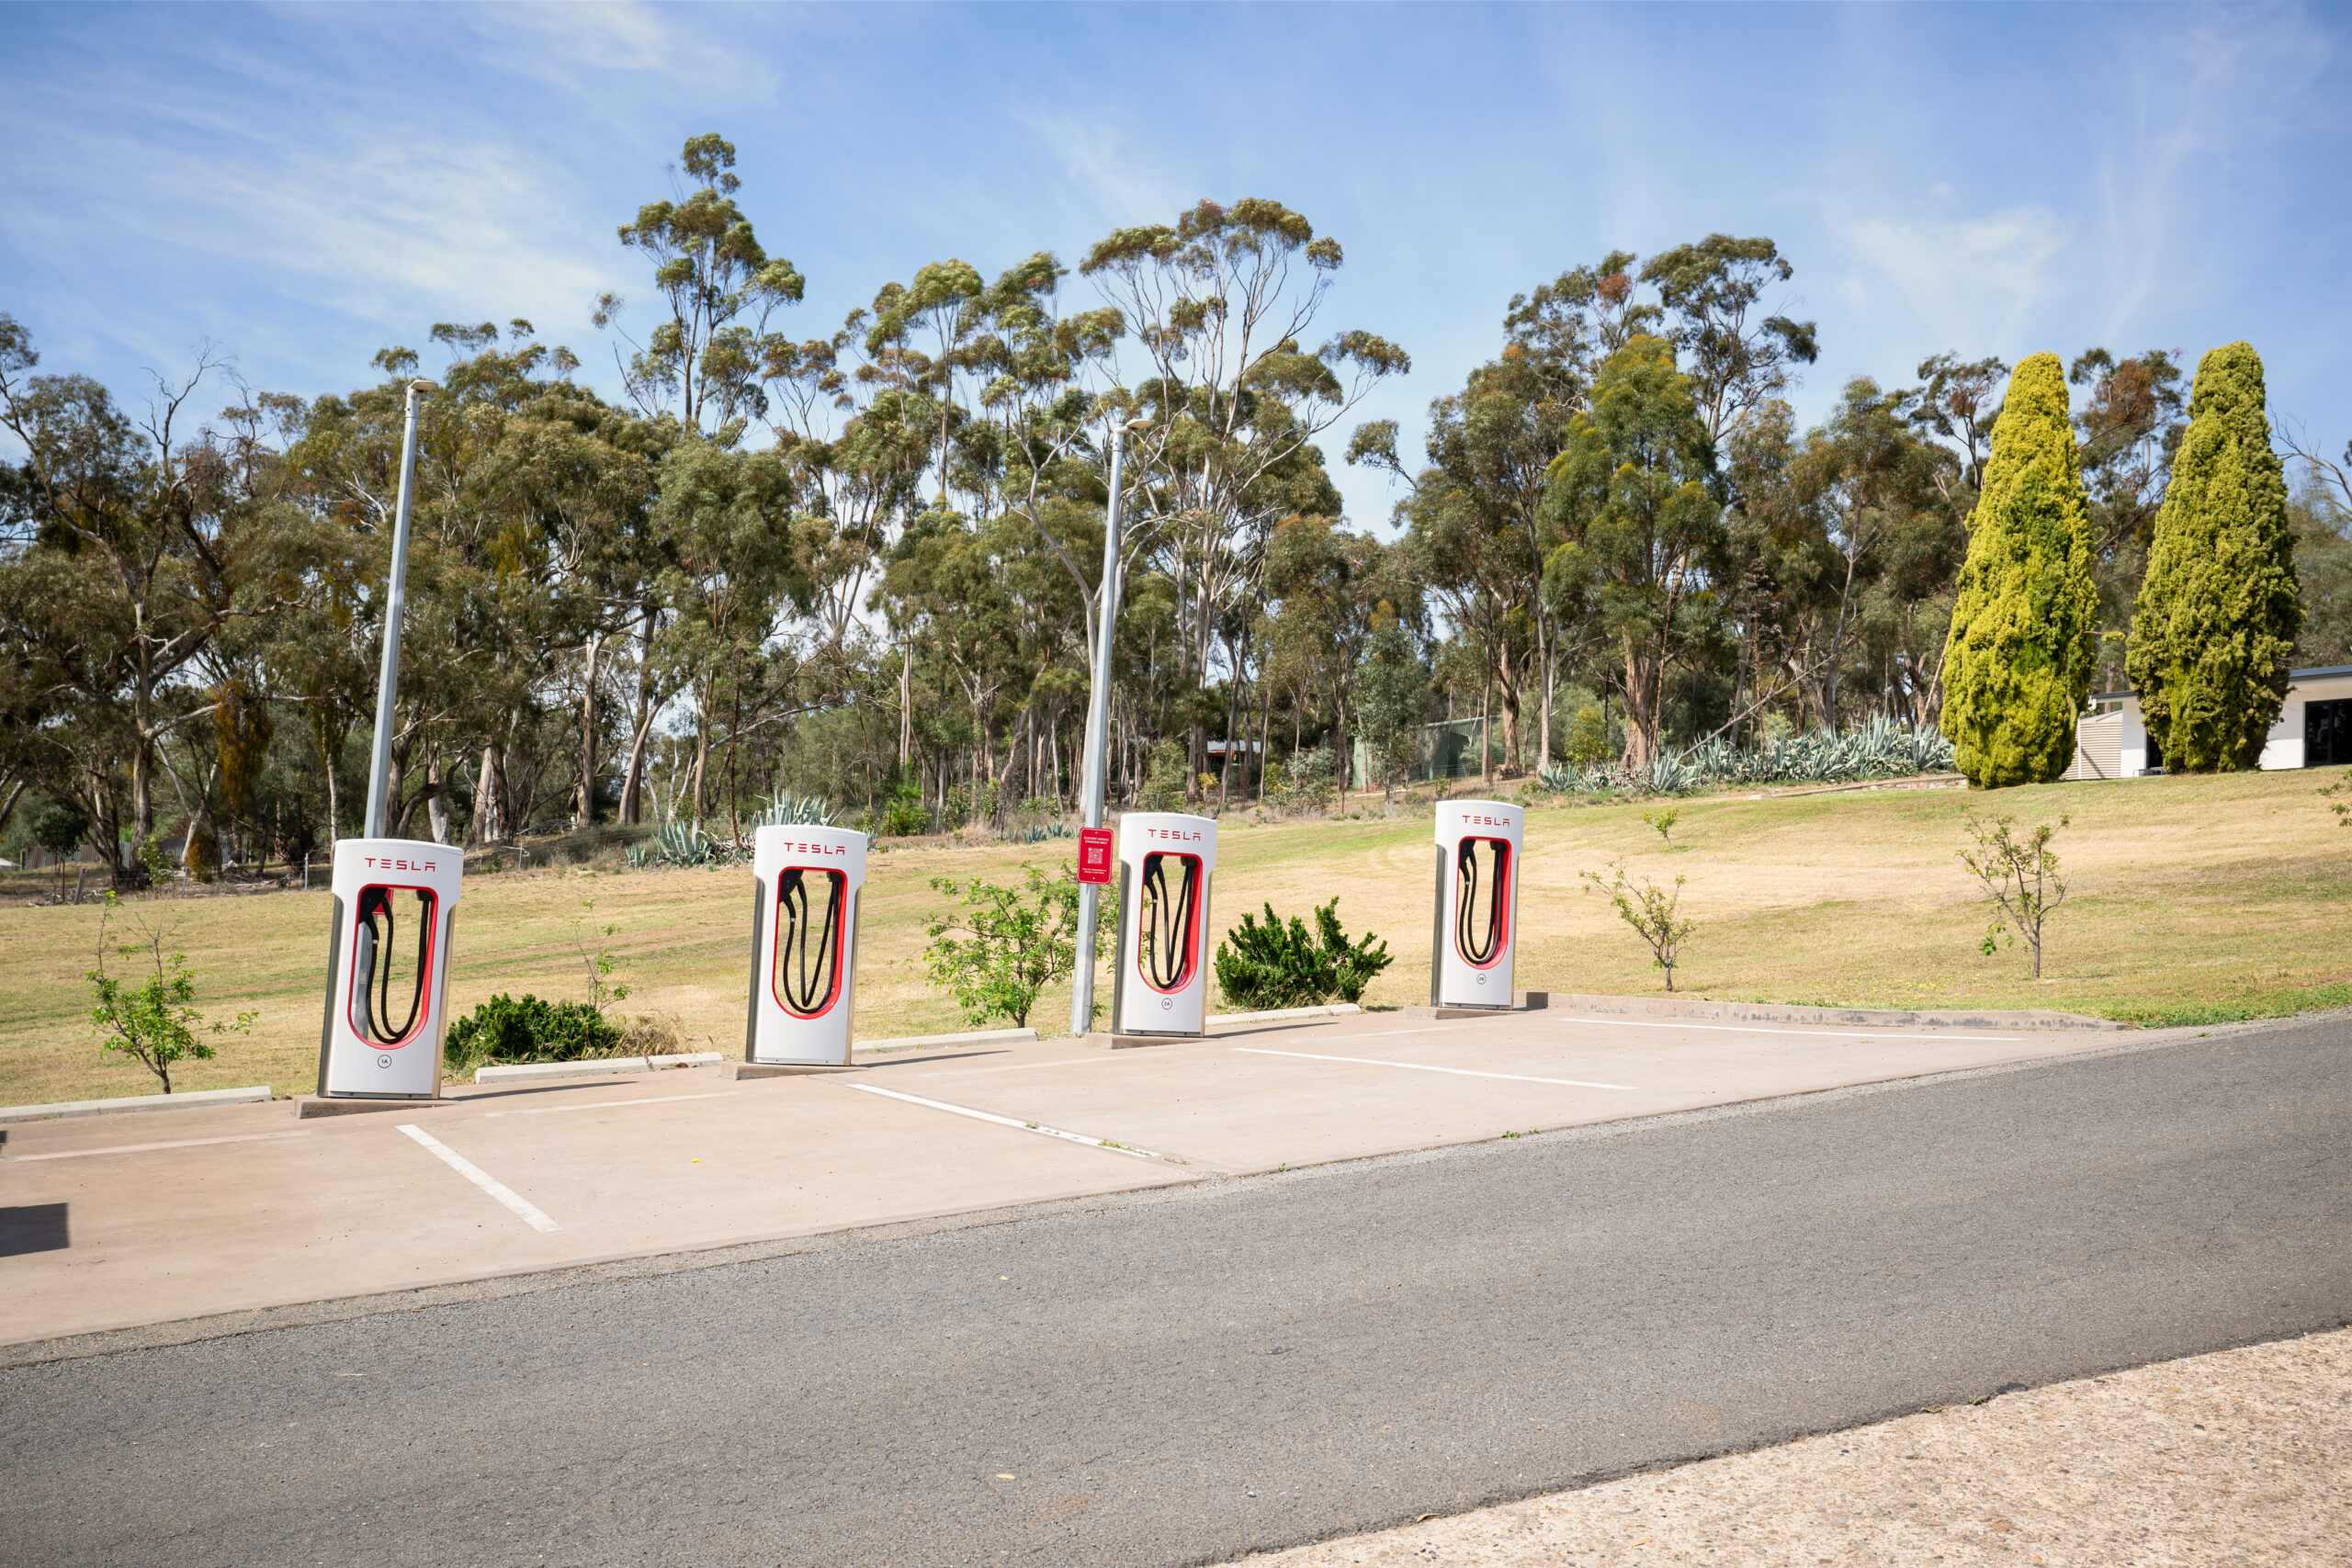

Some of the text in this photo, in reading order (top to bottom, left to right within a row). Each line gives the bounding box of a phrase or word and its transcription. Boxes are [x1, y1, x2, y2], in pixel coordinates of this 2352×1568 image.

[1462, 815, 1510, 827] TESLA
[1148, 829, 1201, 841] TESLA
[784, 842, 845, 855] TESLA
[364, 858, 436, 872] TESLA
